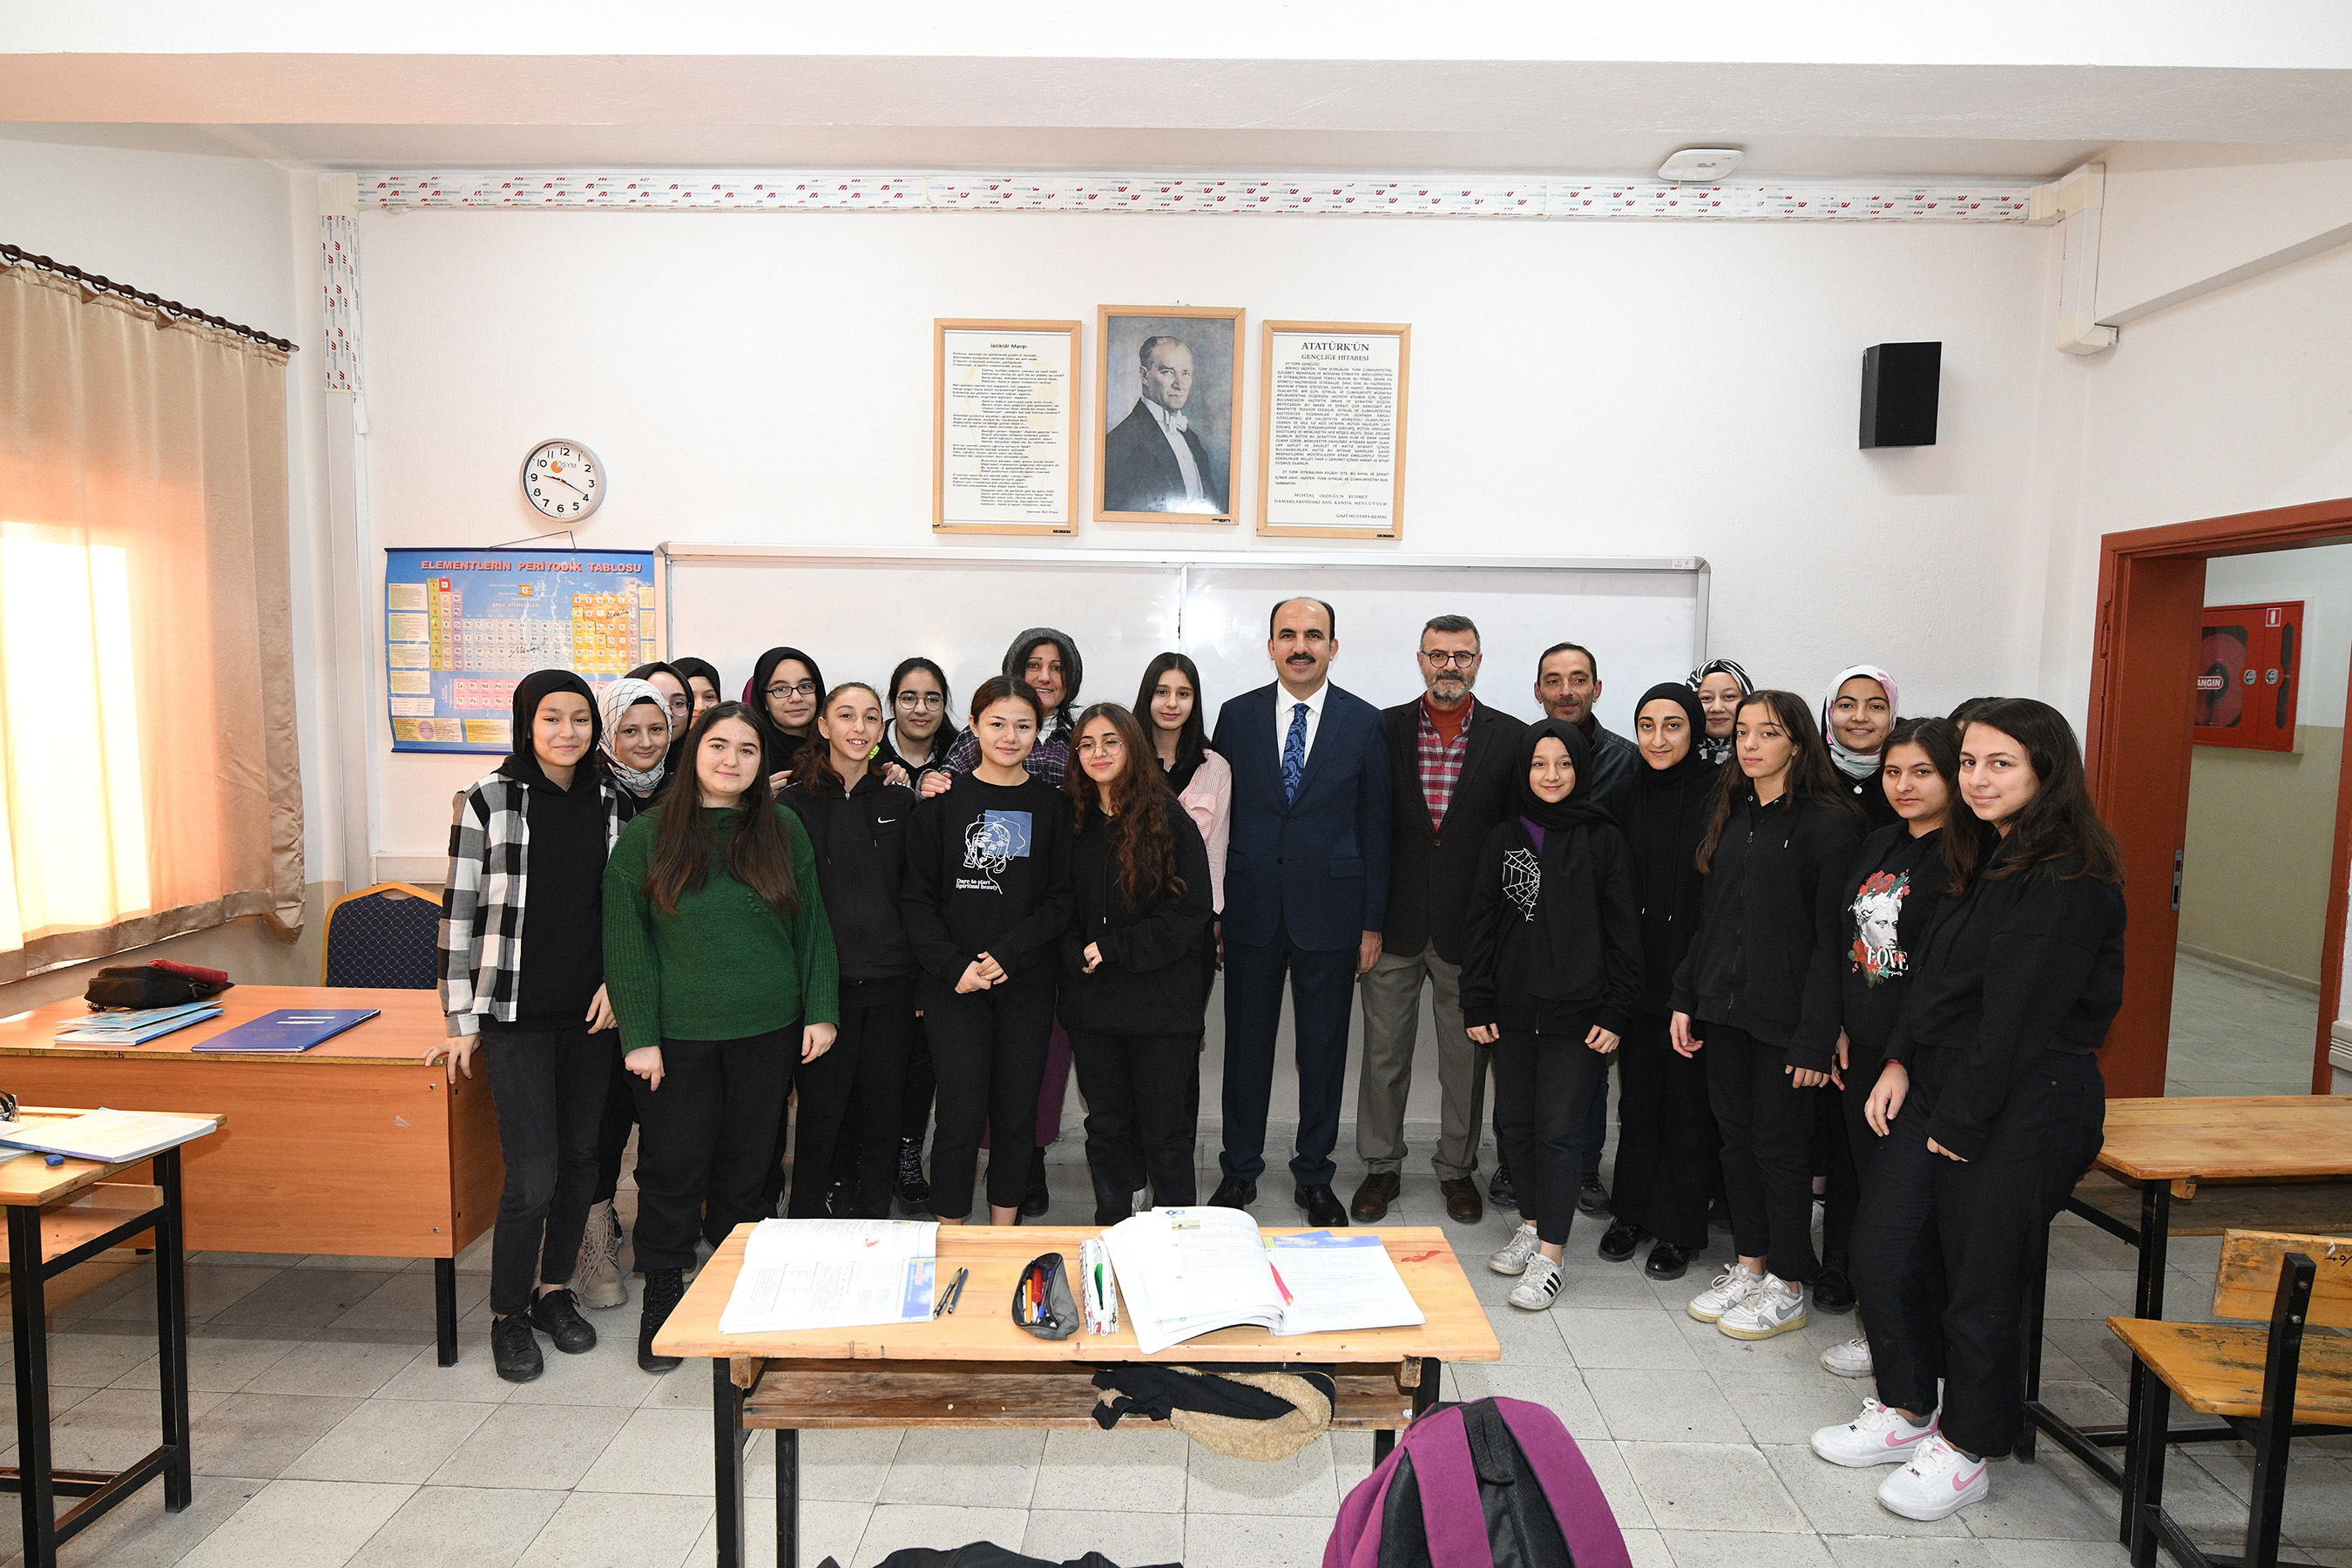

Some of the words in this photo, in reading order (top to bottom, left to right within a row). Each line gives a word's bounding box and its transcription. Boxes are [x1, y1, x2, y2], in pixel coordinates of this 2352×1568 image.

[1301, 342, 1369, 351] ATATÜRK'ÜN
[548, 450, 554, 459] 11
[560, 447, 570, 456] 12
[537, 459, 547, 467] 10
[585, 464, 591, 473] 2
[530, 473, 538, 481] 9
[534, 488, 541, 497] 8
[583, 494, 589, 502] 4
[543, 499, 550, 507] 7
[573, 502, 580, 510] 5
[557, 504, 564, 512] 6
[421, 559, 512, 571] ELEMENTLERİN
[518, 560, 582, 572] PERİYODİK
[588, 563, 642, 573] TABLOSU
[1867, 946, 1908, 970] LOVE
